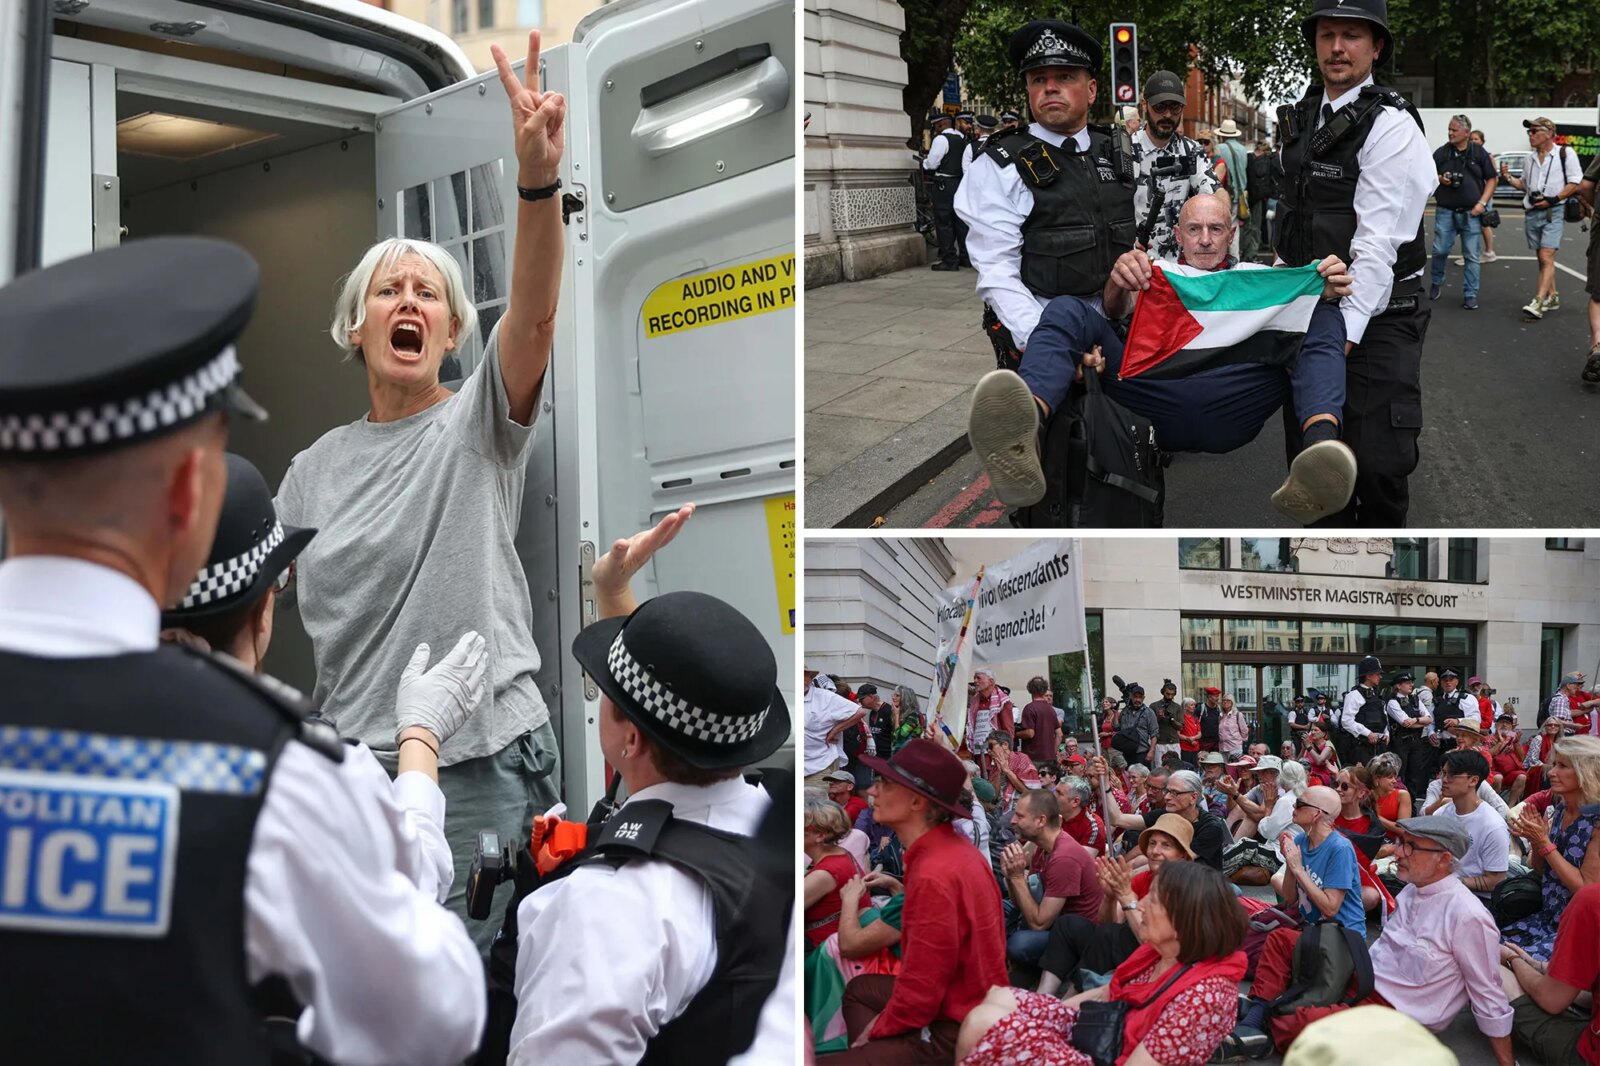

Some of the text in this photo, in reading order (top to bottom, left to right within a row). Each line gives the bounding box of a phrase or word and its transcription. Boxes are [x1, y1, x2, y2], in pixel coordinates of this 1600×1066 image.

[683, 274, 735, 300] AUDIO
[741, 264, 777, 287] AND
[649, 296, 752, 333] RECORDING
[757, 290, 775, 309] IN
[998, 554, 1069, 601] descendants
[1333, 559, 1354, 570] 2011
[1221, 585, 1458, 608] WESTMINSTER MAGISTRATES COURT
[976, 605, 1045, 646] Gaza genocide!
[0, 791, 161, 829] OLITAN
[614, 830, 639, 840] 1712
[3, 827, 158, 916] ICE
